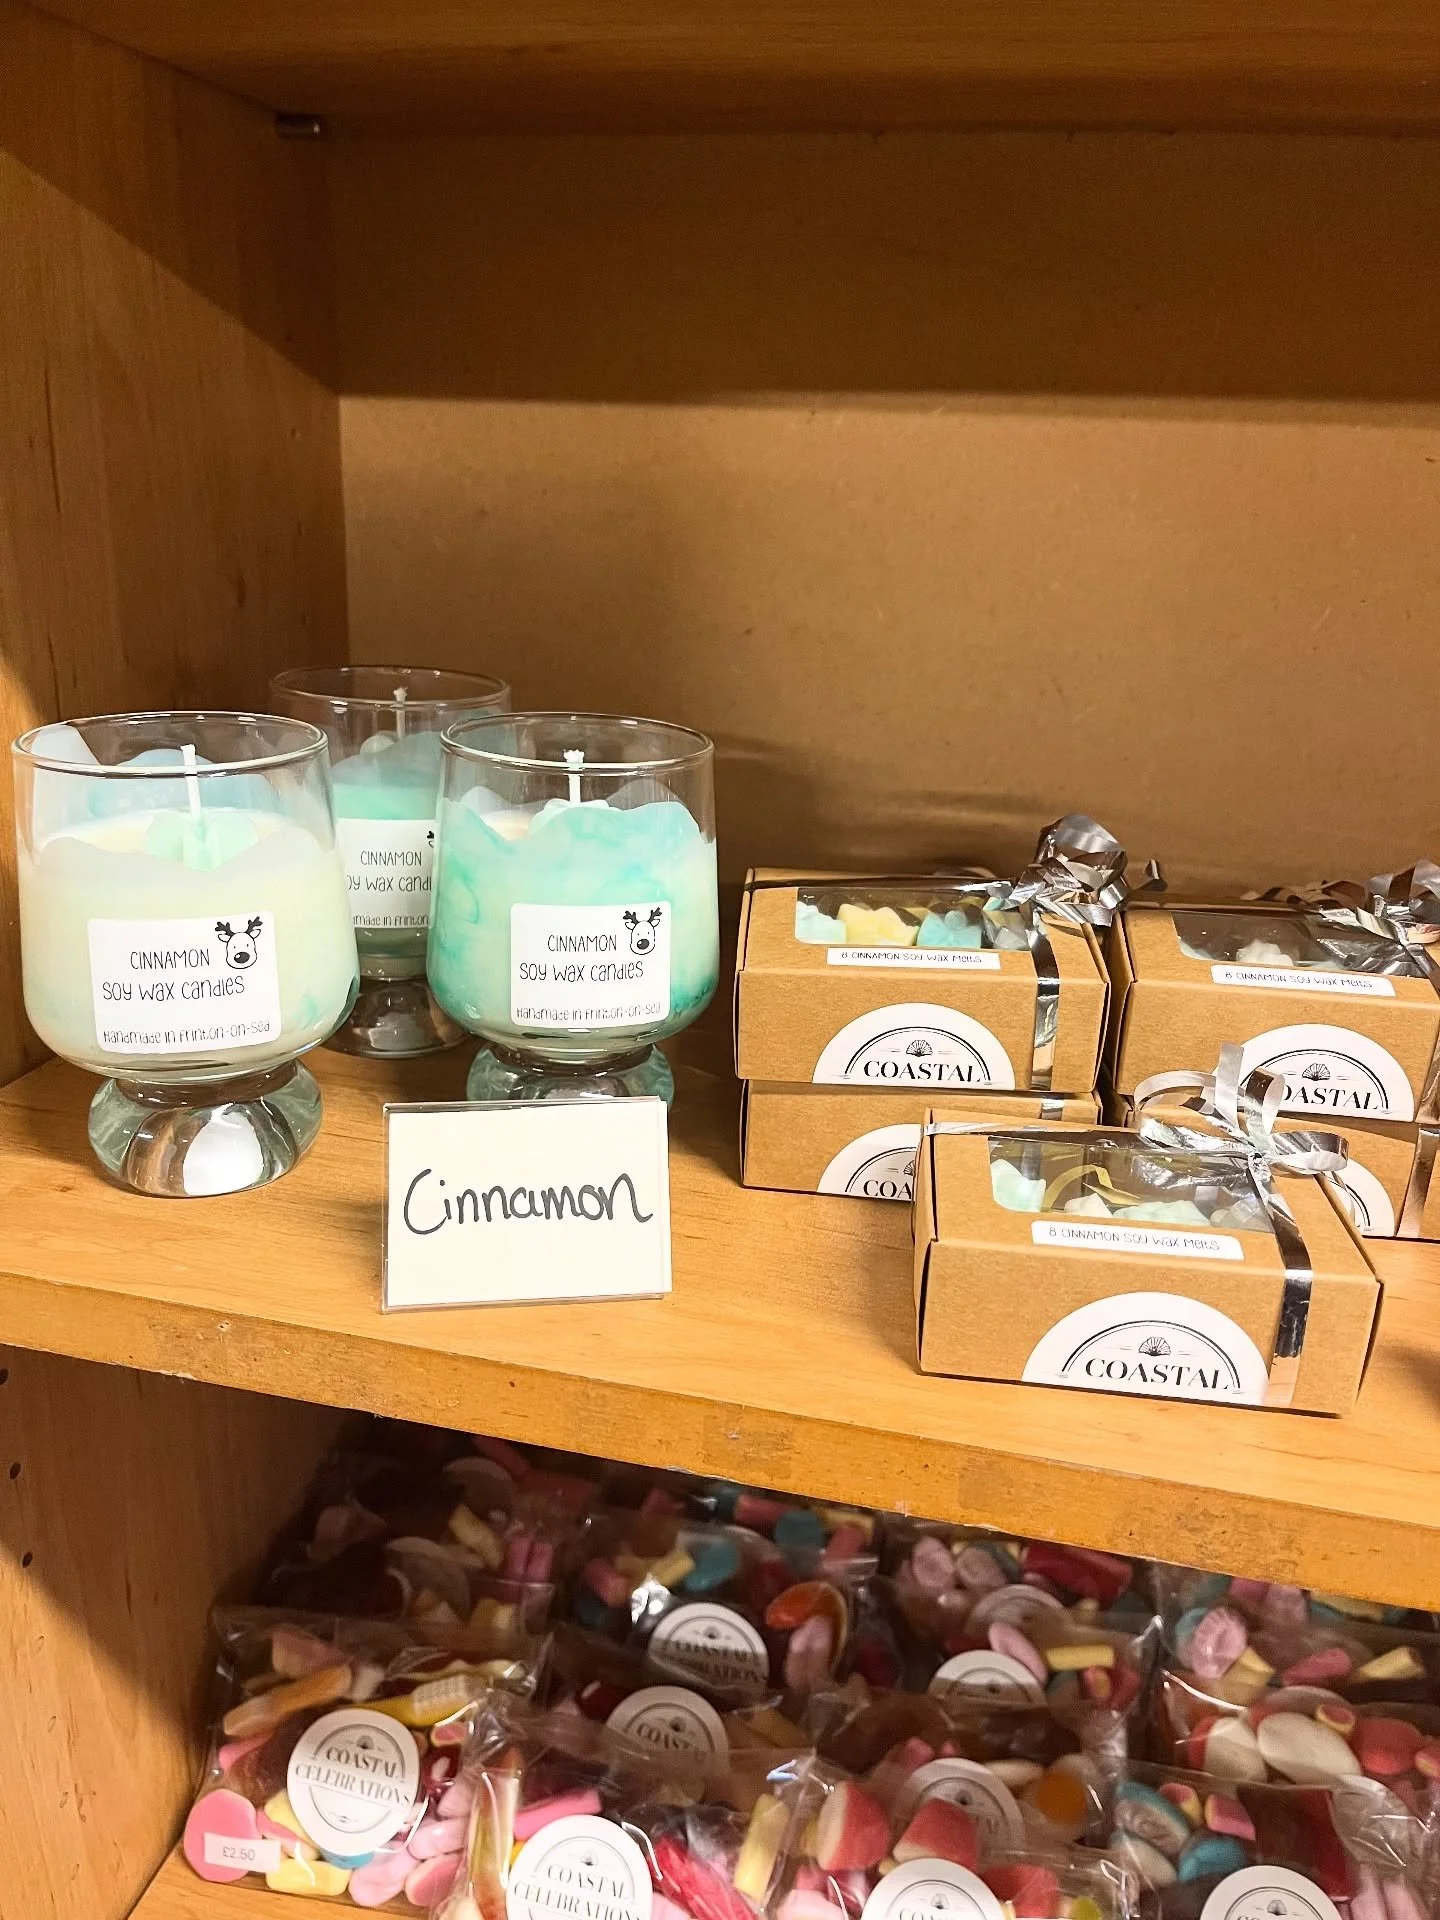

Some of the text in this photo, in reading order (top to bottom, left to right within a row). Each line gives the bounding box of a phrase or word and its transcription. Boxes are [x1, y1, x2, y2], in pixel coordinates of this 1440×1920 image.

[360, 850, 422, 867] CINNAMON
[365, 876, 394, 892] wax
[398, 875, 432, 892] candl
[547, 934, 617, 953] CINNAMON
[130, 948, 210, 970] CINNAMON
[851, 951, 900, 960] CINNAMON
[590, 960, 644, 982] candles
[1236, 972, 1287, 982] CINNAMON
[181, 975, 245, 1000] candles
[516, 1006, 570, 1021] Handmade
[572, 1007, 582, 1021] in
[103, 1029, 161, 1044] Handmade
[165, 1029, 176, 1043] in
[863, 1060, 981, 1083] COASTAL
[1283, 1084, 1379, 1110] ASTAL
[403, 1168, 653, 1235] Cinnamon
[1049, 1226, 1057, 1237] 8
[1061, 1228, 1120, 1242] CINNAMON
[1085, 1358, 1229, 1390] COASTAL
[326, 1745, 400, 1780] COASTAL
[295, 1763, 411, 1805] CELEBRATIONS
[223, 1846, 256, 1861] £2.50
[547, 1864, 630, 1899] COASTAL
